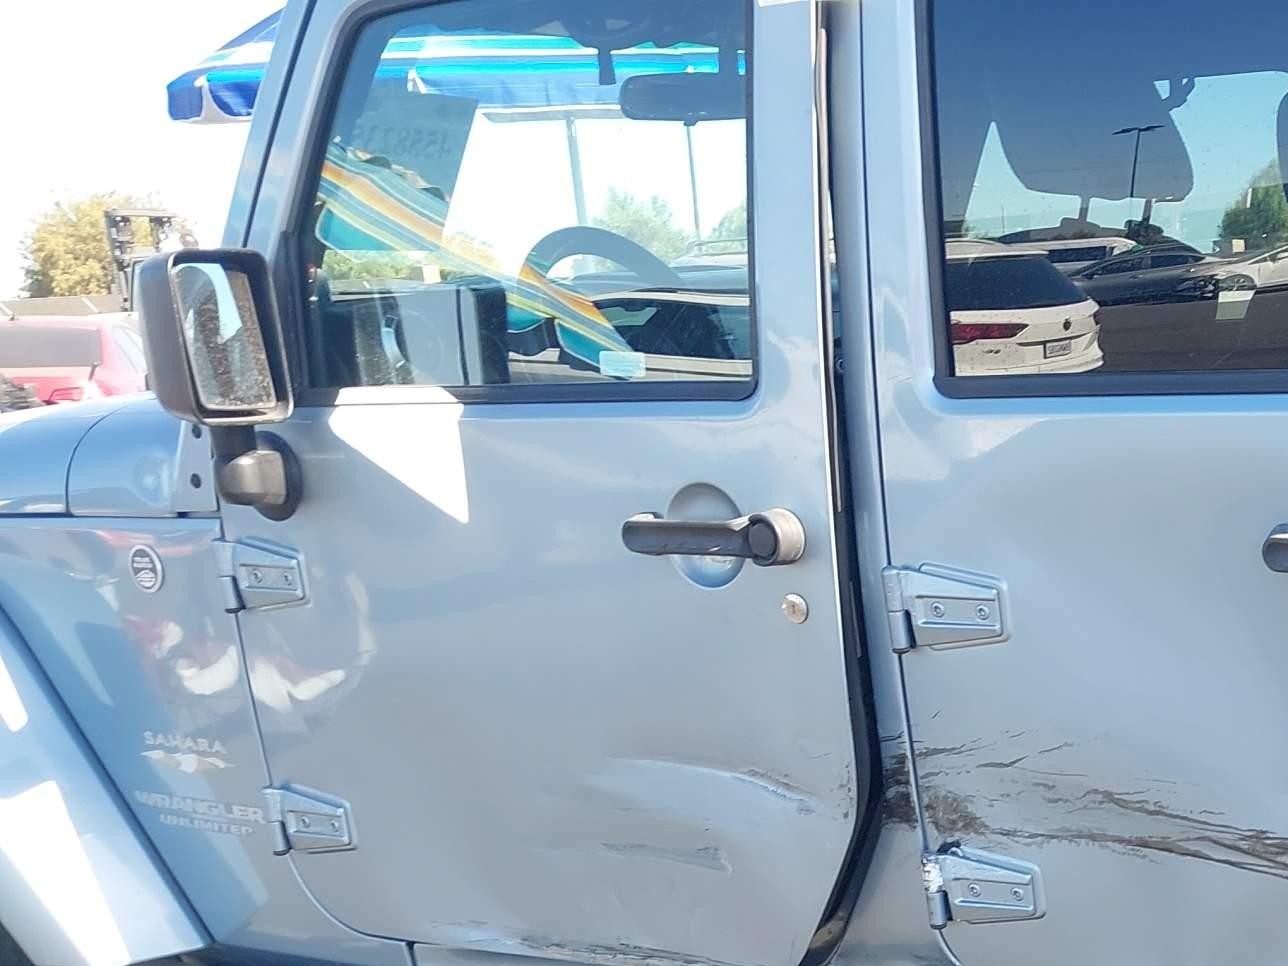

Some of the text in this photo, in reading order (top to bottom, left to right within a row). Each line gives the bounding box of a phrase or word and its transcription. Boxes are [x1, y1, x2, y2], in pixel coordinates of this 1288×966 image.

[143, 730, 227, 754] SAHARA
[134, 790, 266, 825] WRANGLER
[160, 813, 254, 837] UNLIMITED
